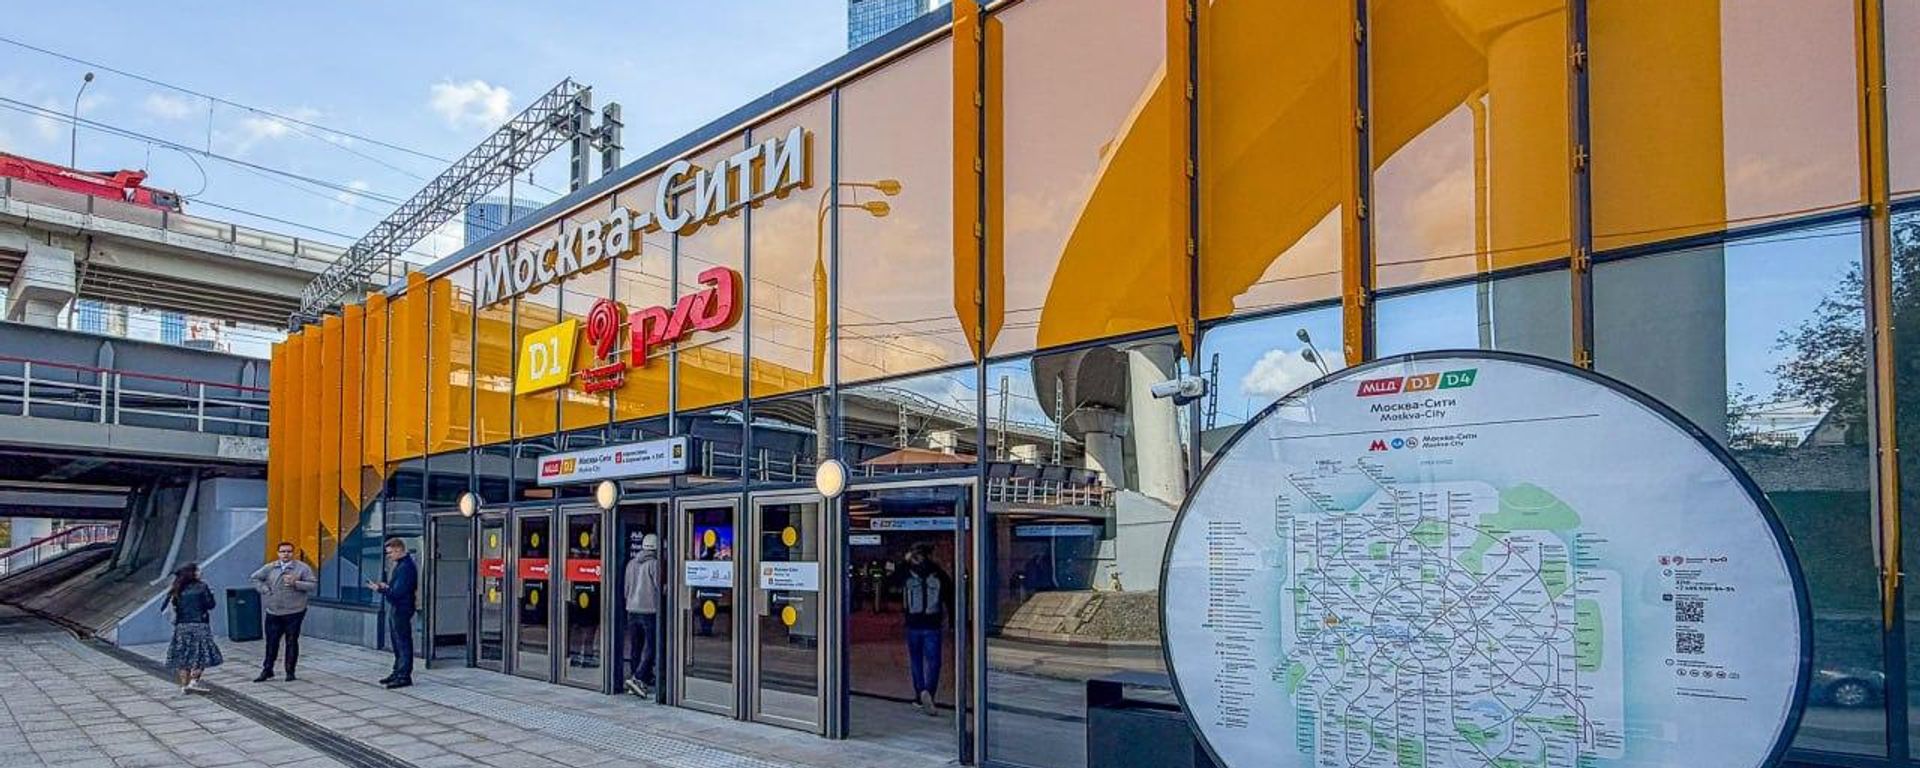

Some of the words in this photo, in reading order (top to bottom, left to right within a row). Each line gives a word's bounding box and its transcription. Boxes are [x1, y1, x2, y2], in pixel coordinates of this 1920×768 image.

[477, 126, 807, 310] Москва-Сити
[529, 336, 561, 382] D1
[1363, 383, 1397, 394] МЦД
[1411, 377, 1432, 389] D1
[1446, 373, 1470, 386] D4
[1370, 399, 1456, 412] Москва-Сити
[1380, 410, 1446, 421] Moskva-City
